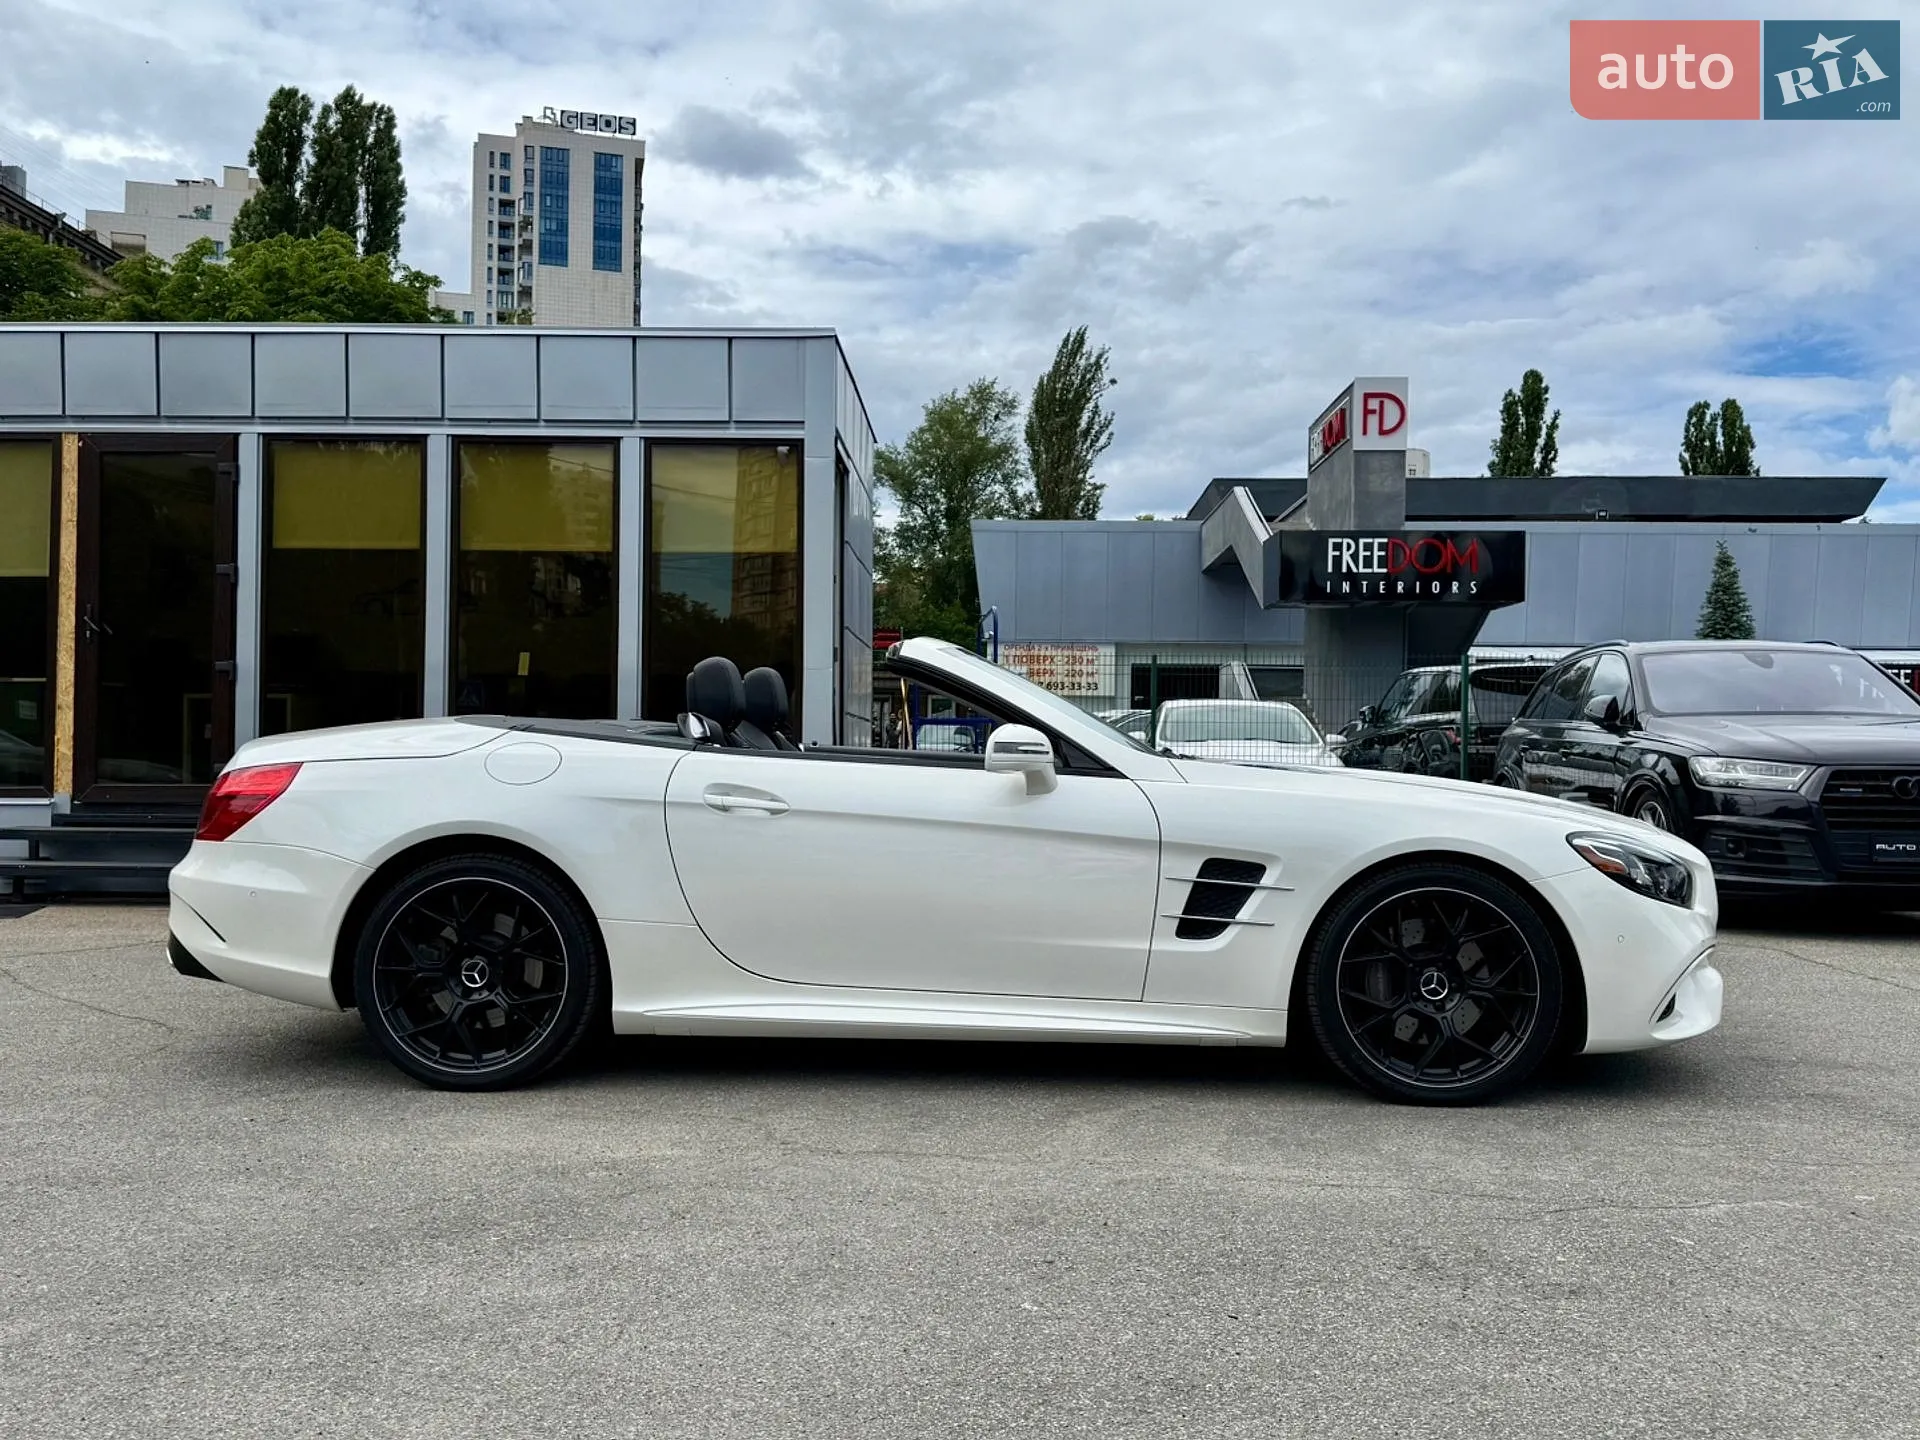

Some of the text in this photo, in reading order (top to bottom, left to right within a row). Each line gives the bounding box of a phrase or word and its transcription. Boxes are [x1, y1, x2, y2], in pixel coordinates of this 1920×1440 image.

[561, 110, 636, 135] GEOS
[1362, 392, 1406, 436] FD
[1327, 538, 1479, 575] FREEDOM
[1326, 581, 1478, 594] INTERIORS
[1013, 655, 1056, 664] ПОВЕРХ
[1046, 681, 1099, 691] 693-33-33
[1875, 843, 1916, 851] AUTO
